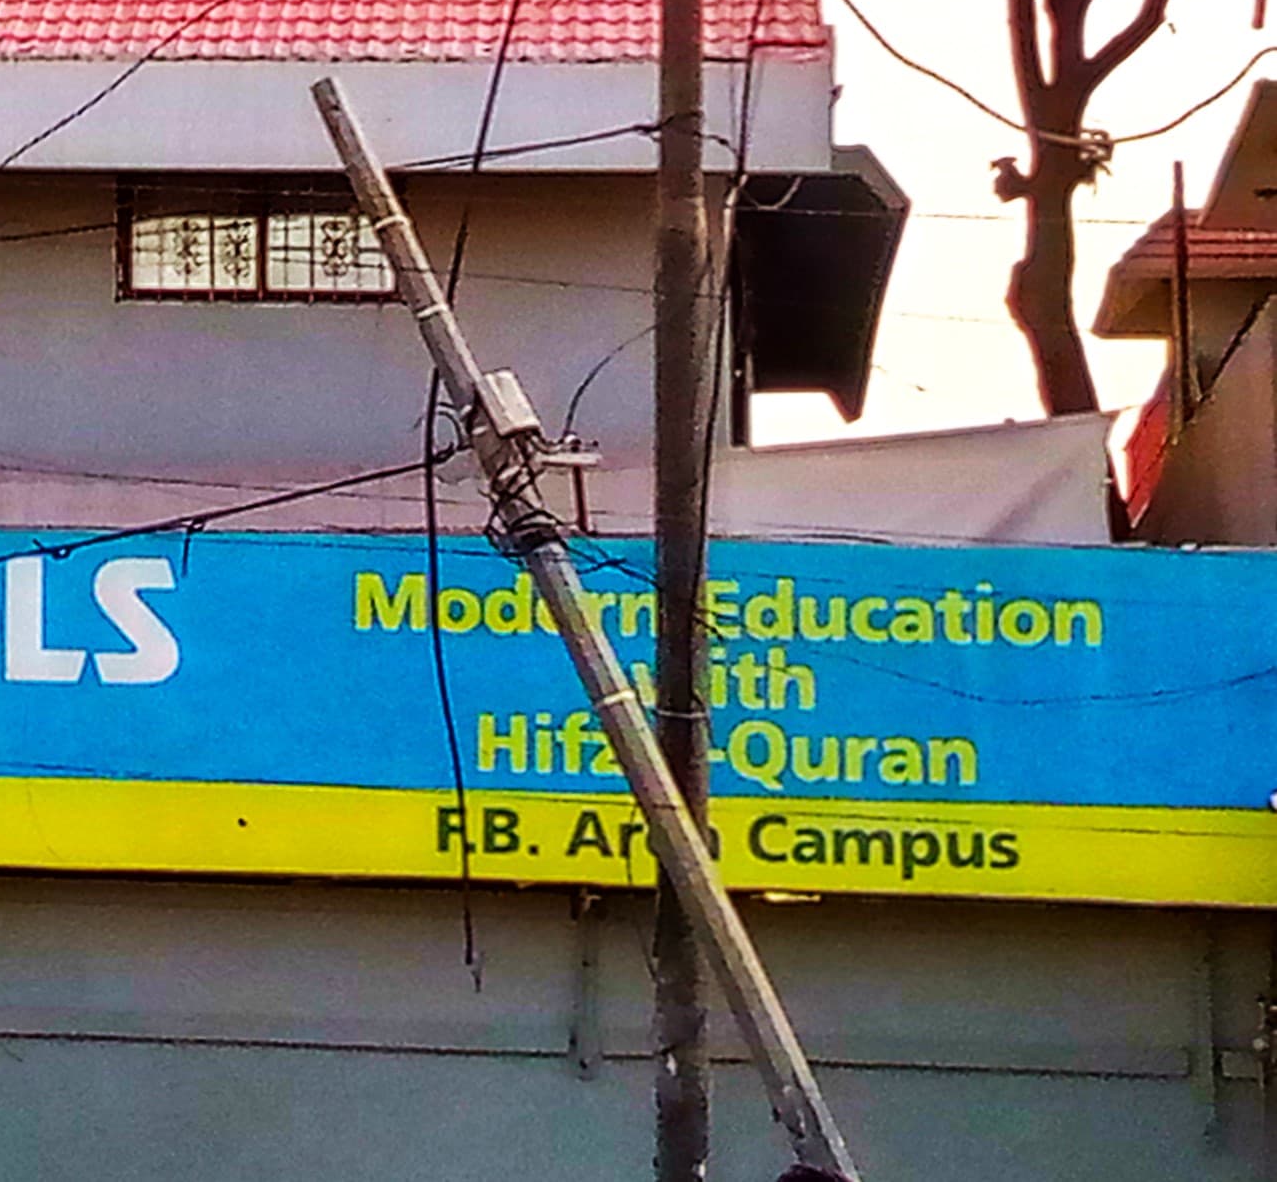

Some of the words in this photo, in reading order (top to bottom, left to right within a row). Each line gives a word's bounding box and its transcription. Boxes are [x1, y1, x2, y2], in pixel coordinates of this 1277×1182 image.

[705, 577, 1105, 648] Education
[564, 809, 721, 861] Ar
[746, 812, 1022, 882] Campus
